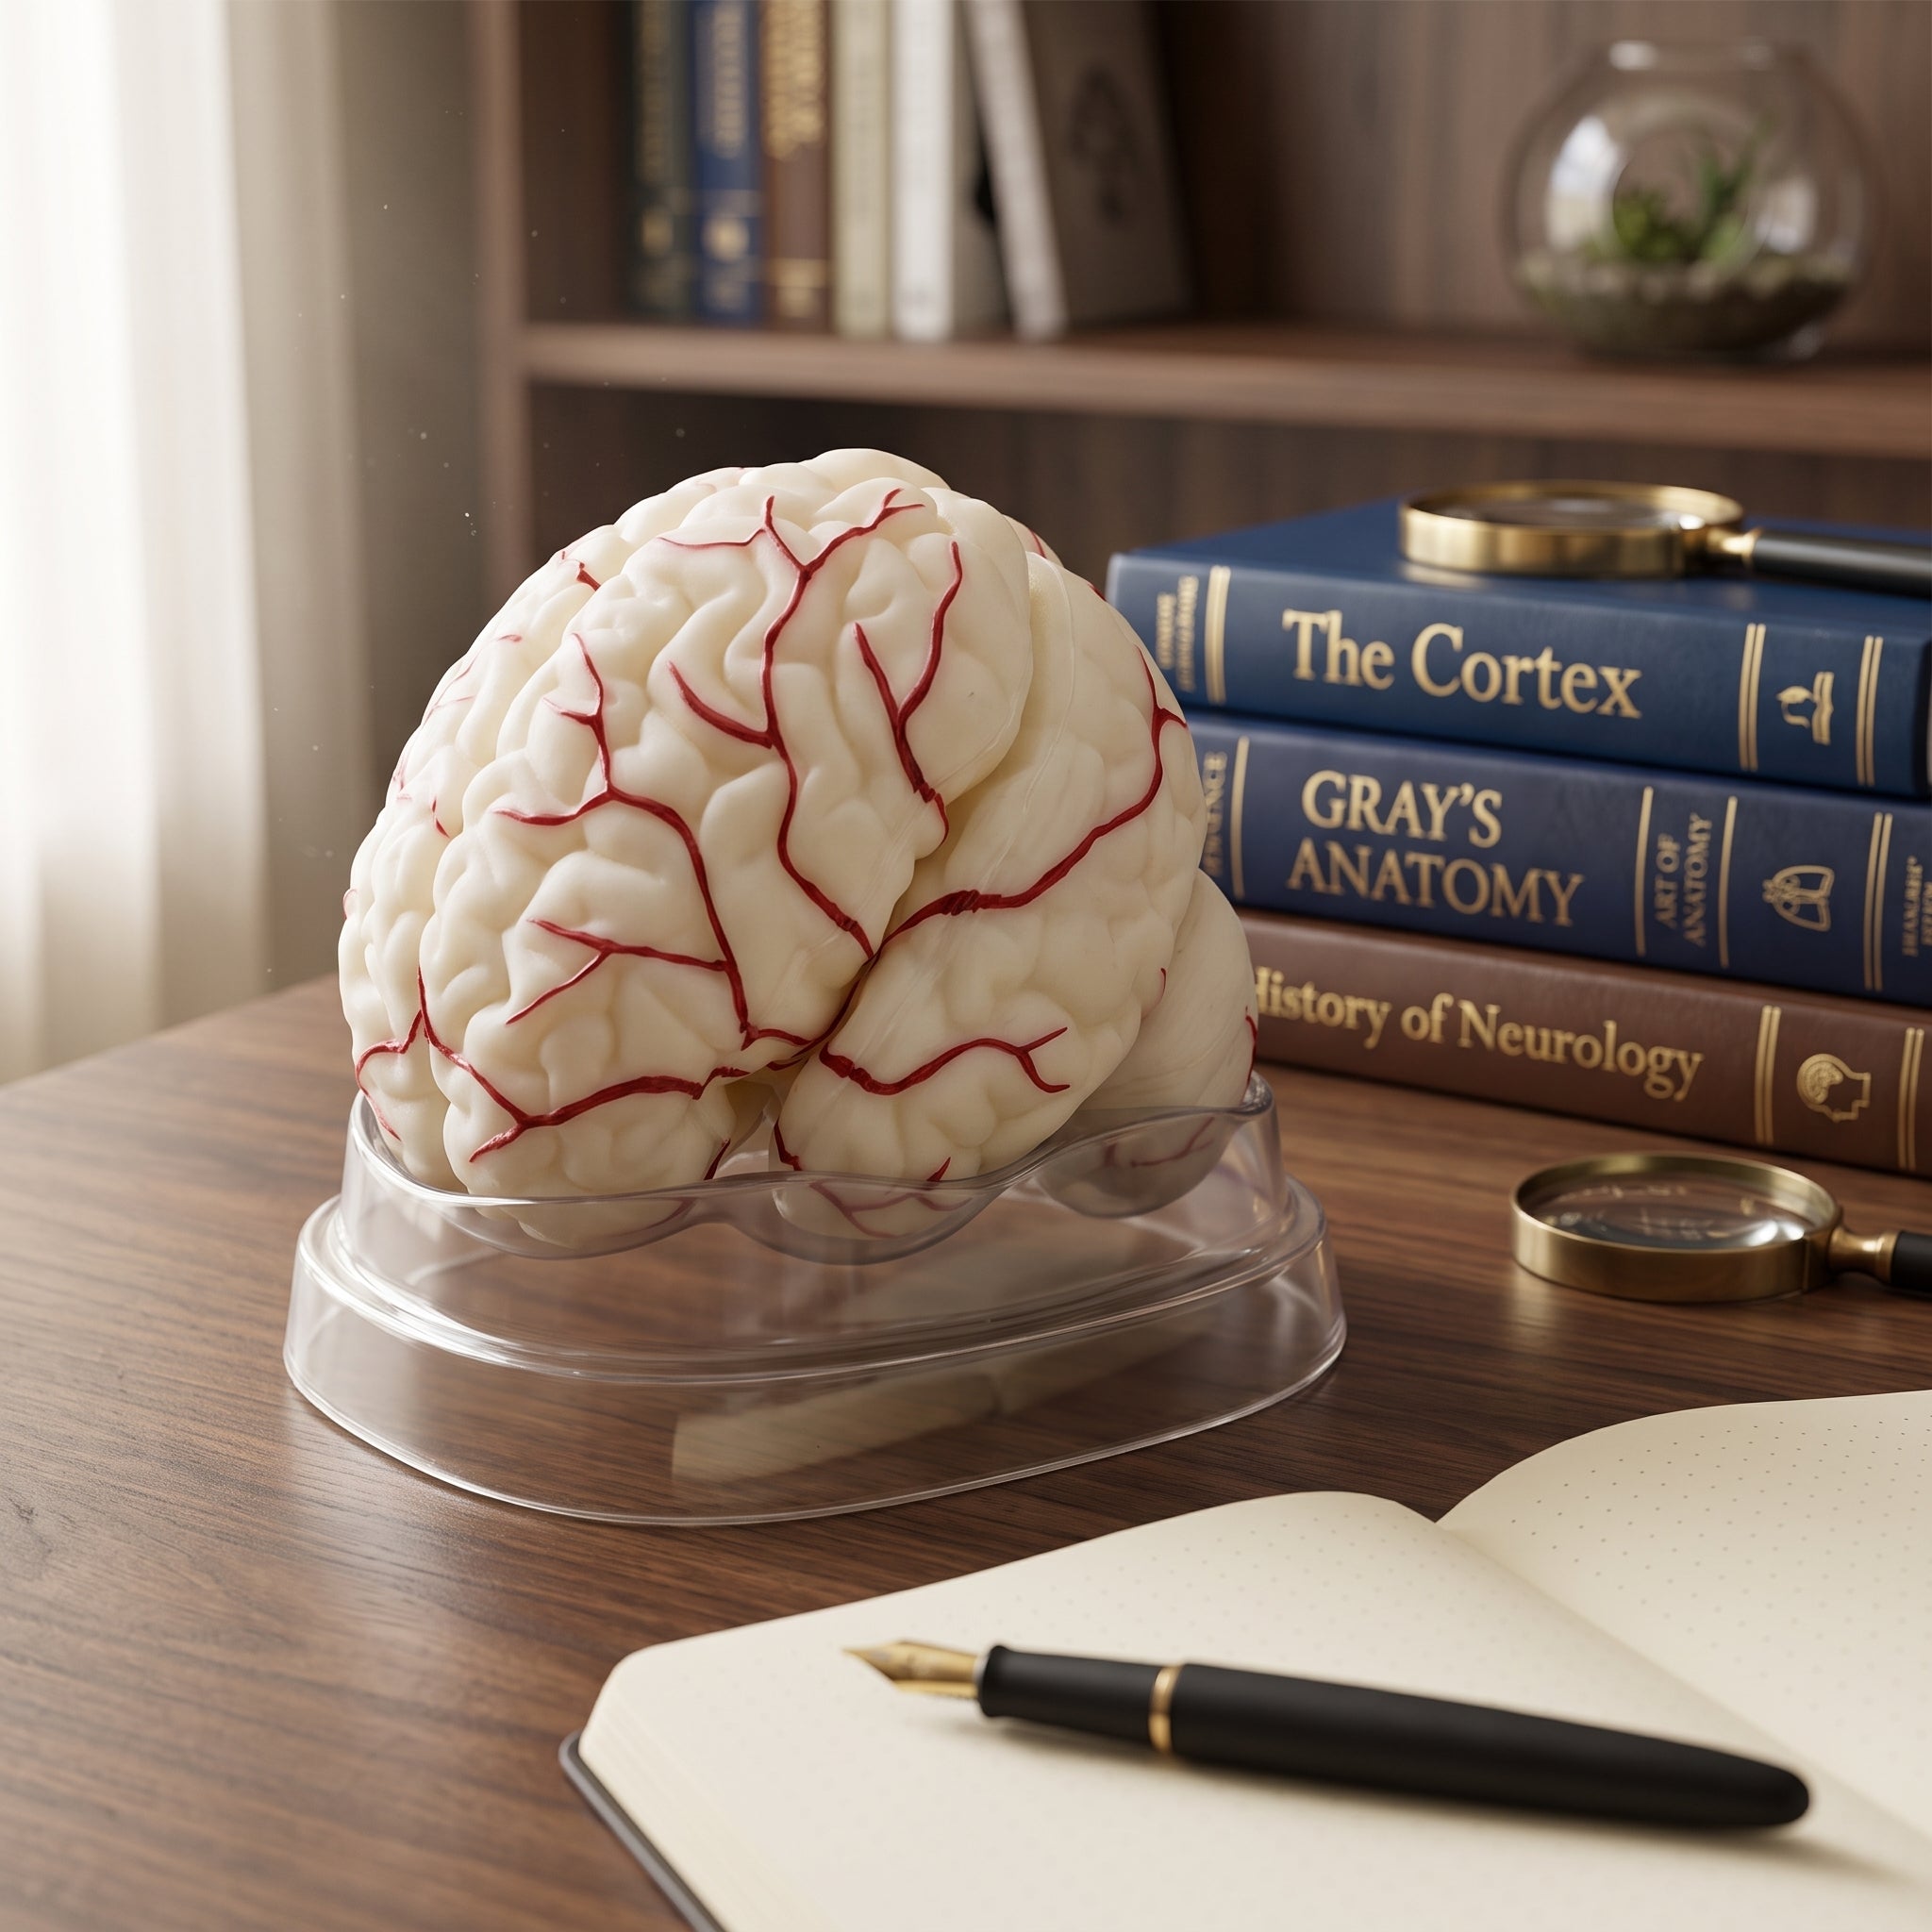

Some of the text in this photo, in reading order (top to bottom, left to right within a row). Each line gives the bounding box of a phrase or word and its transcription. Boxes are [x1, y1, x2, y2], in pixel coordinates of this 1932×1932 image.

[1282, 608, 1395, 691] The
[1411, 623, 1642, 719] Cortex
[1301, 769, 1504, 849] GRAY'S
[1286, 837, 1585, 927] ANATOMY
[1654, 833, 1681, 929] ART OF
[1683, 812, 1713, 947] ANATOMY
[1400, 992, 1454, 1044] of
[1457, 998, 1705, 1101] Neurology
